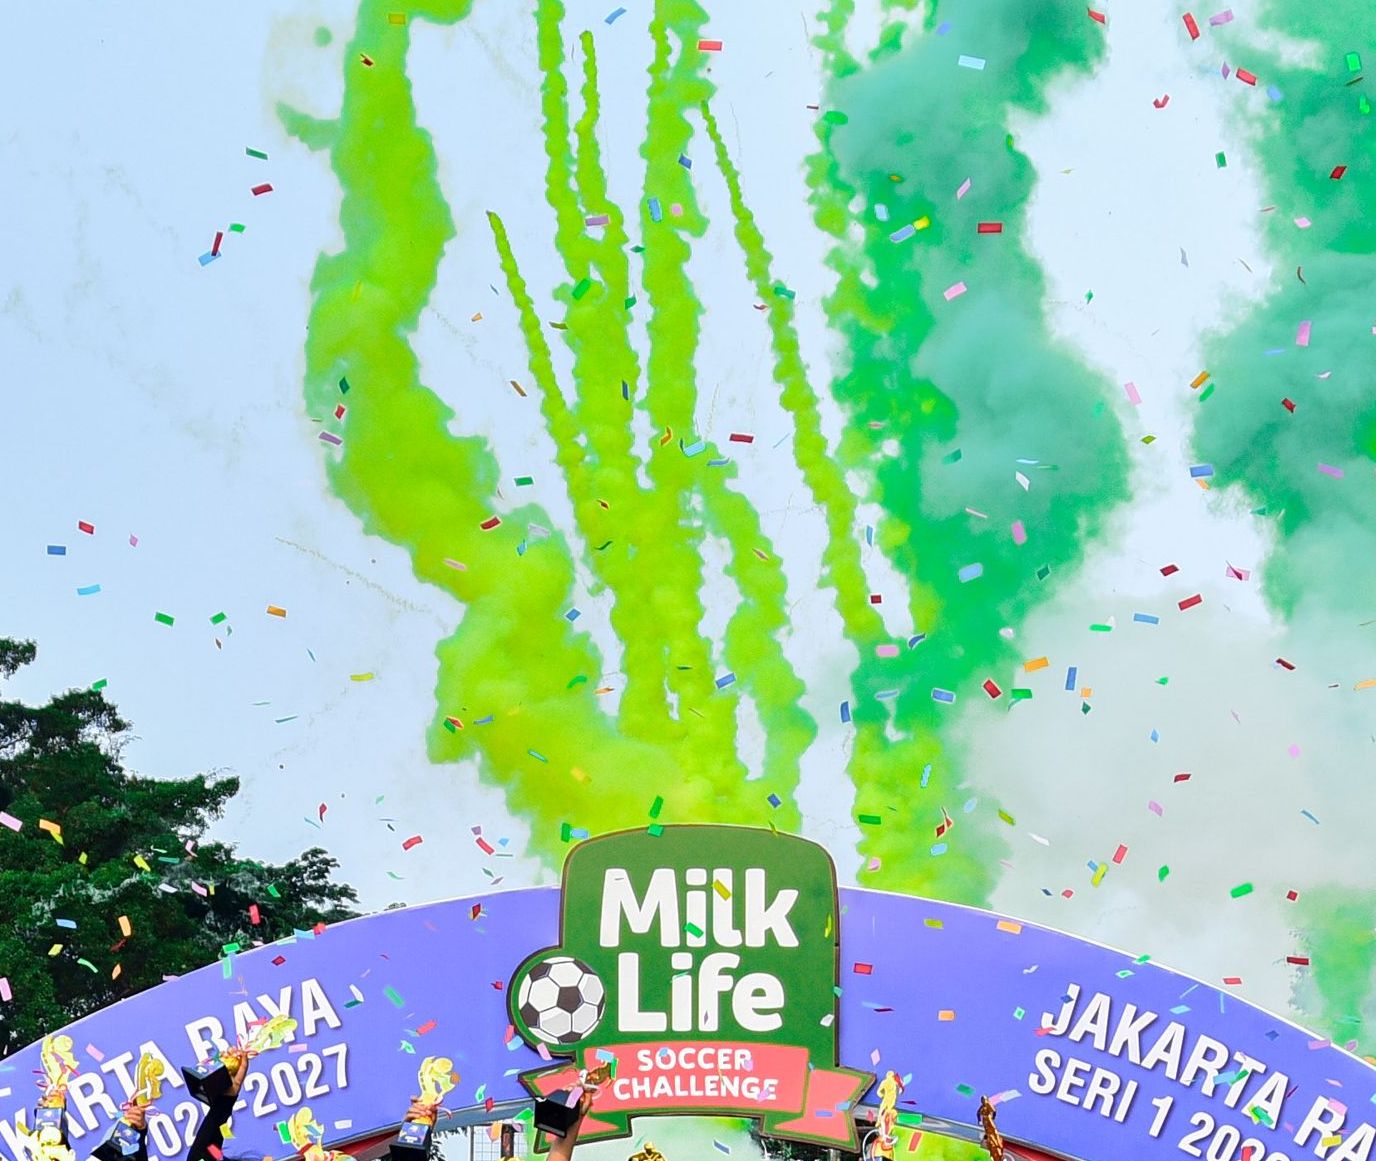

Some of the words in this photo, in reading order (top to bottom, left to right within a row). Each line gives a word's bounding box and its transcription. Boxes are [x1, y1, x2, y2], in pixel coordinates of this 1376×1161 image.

[599, 868, 799, 947] Milk
[618, 952, 785, 1032] Life
[613, 1076, 778, 1101] CHALLENGE
[637, 1048, 752, 1072] SOCCER
[1029, 1049, 1139, 1123] SERI
[1149, 1096, 1174, 1138] 1
[1042, 983, 1290, 1130] JAKARTA
